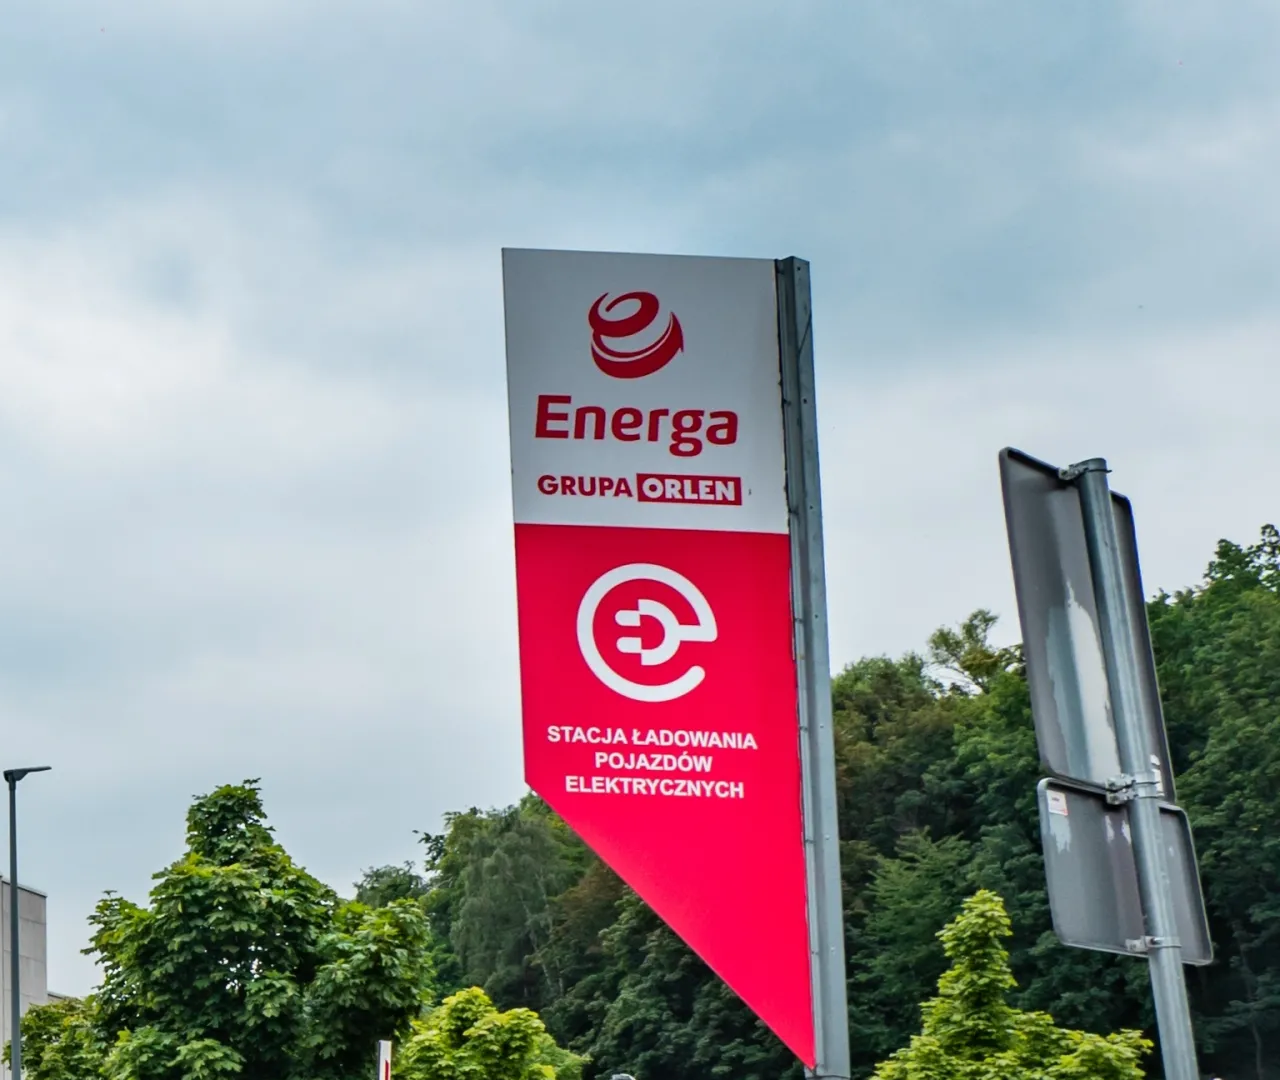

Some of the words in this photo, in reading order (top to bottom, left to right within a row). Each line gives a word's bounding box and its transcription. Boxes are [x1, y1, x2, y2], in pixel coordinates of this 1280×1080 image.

[535, 394, 738, 457] Energa
[537, 475, 633, 498] GRUPA
[641, 476, 737, 502] ORLEN
[547, 725, 627, 745] STACJA
[631, 728, 757, 750] ŁADOWANIA
[595, 751, 713, 772] POJAZDÓW
[565, 775, 744, 799] ELEKTRYCZNYCH
